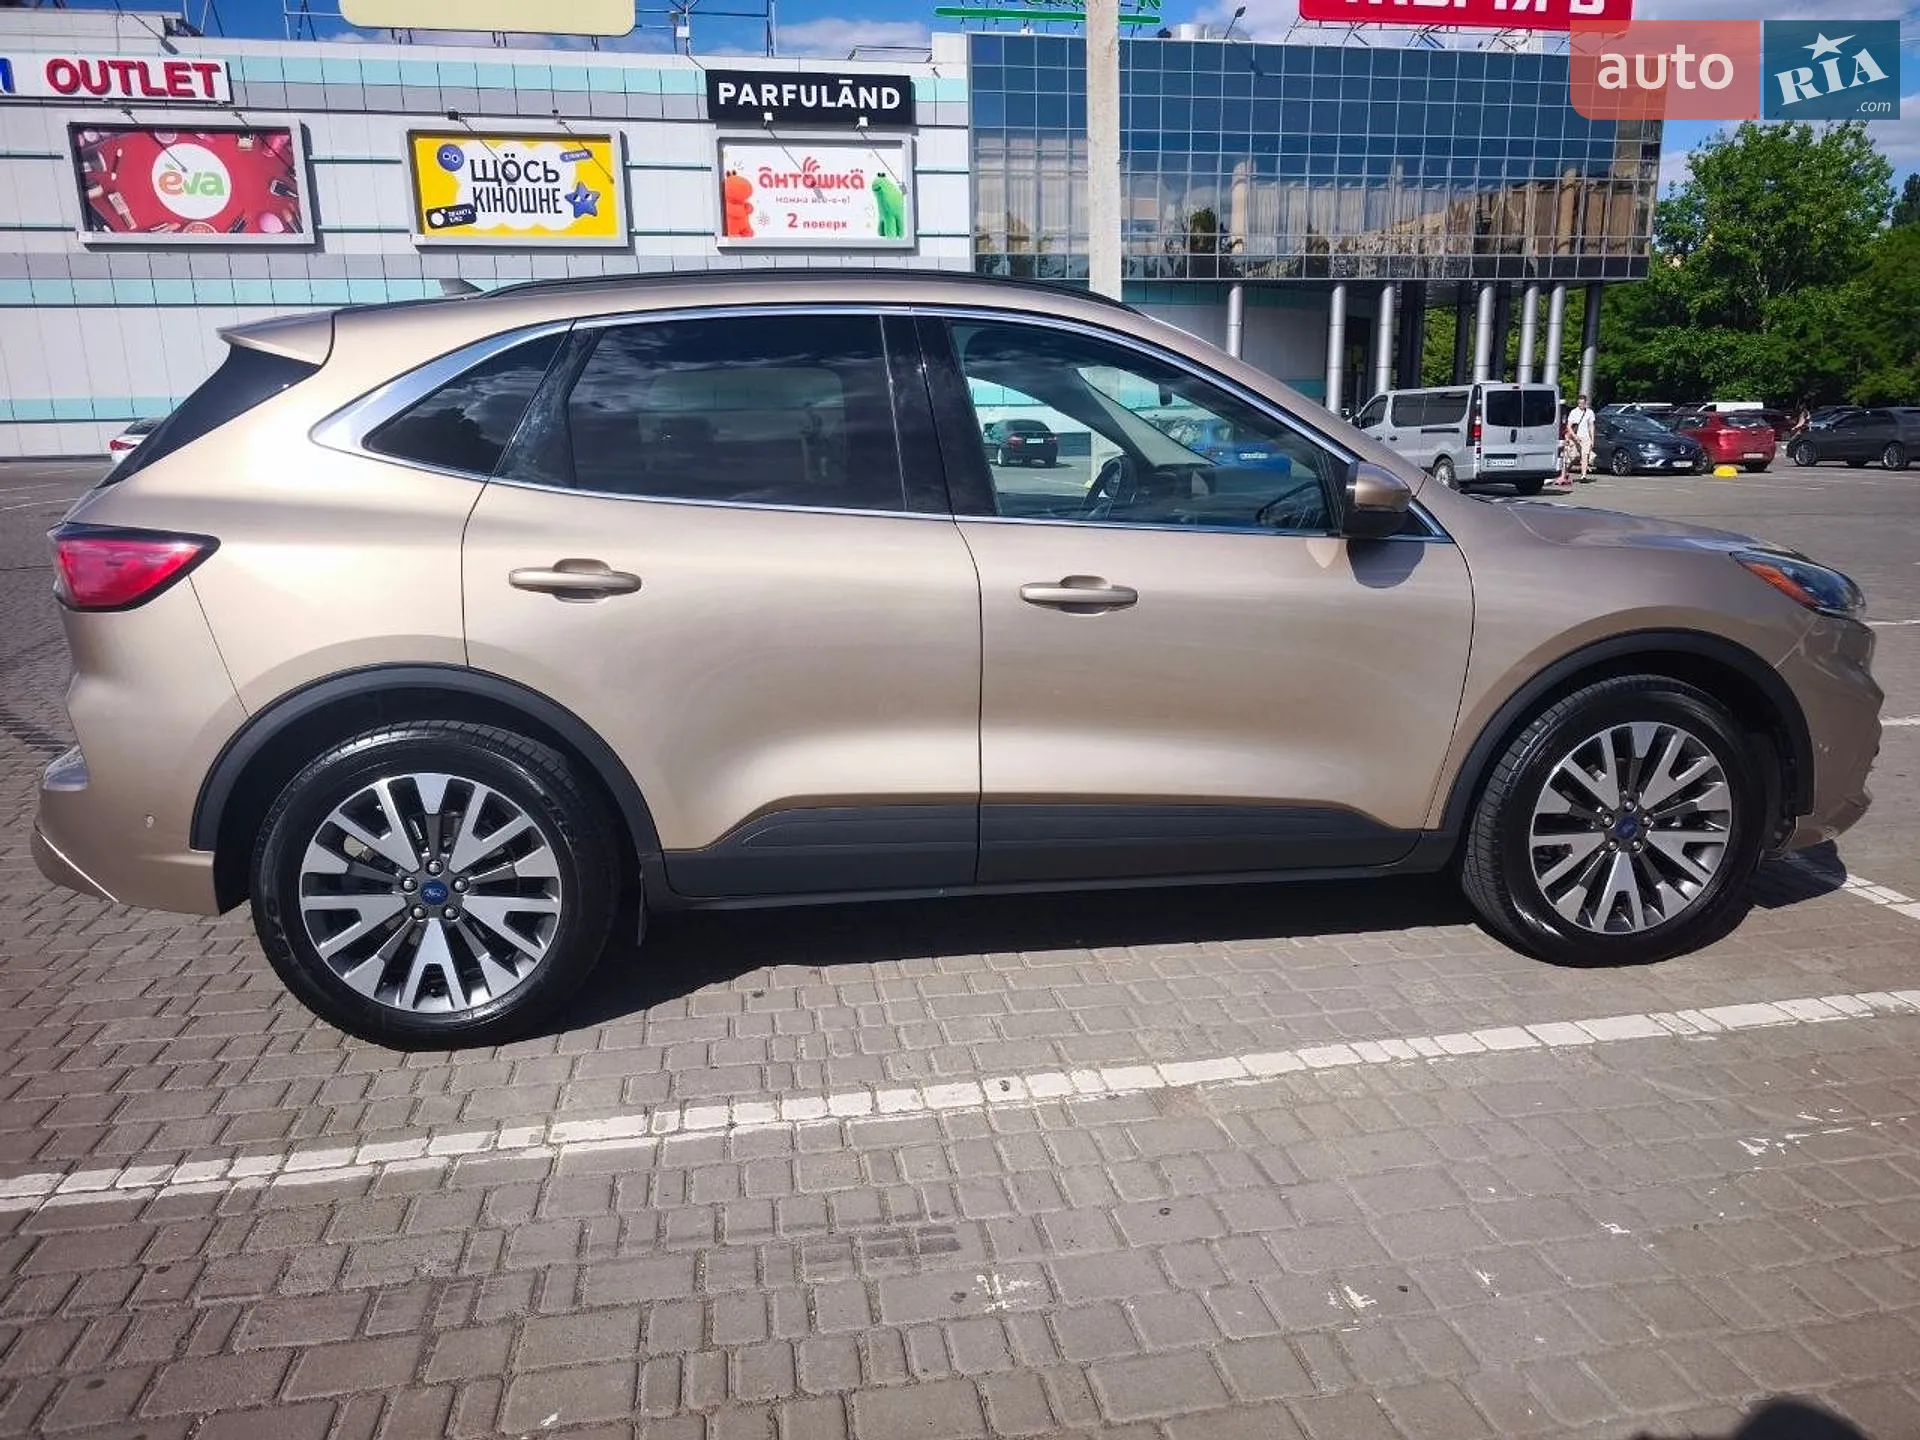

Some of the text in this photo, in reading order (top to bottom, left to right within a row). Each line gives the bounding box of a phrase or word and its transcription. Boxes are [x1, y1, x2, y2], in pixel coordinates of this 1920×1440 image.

[46, 57, 221, 99] OUTLET
[472, 187, 563, 214] КІНОШНЕ
[787, 212, 848, 231] 2 поверх
